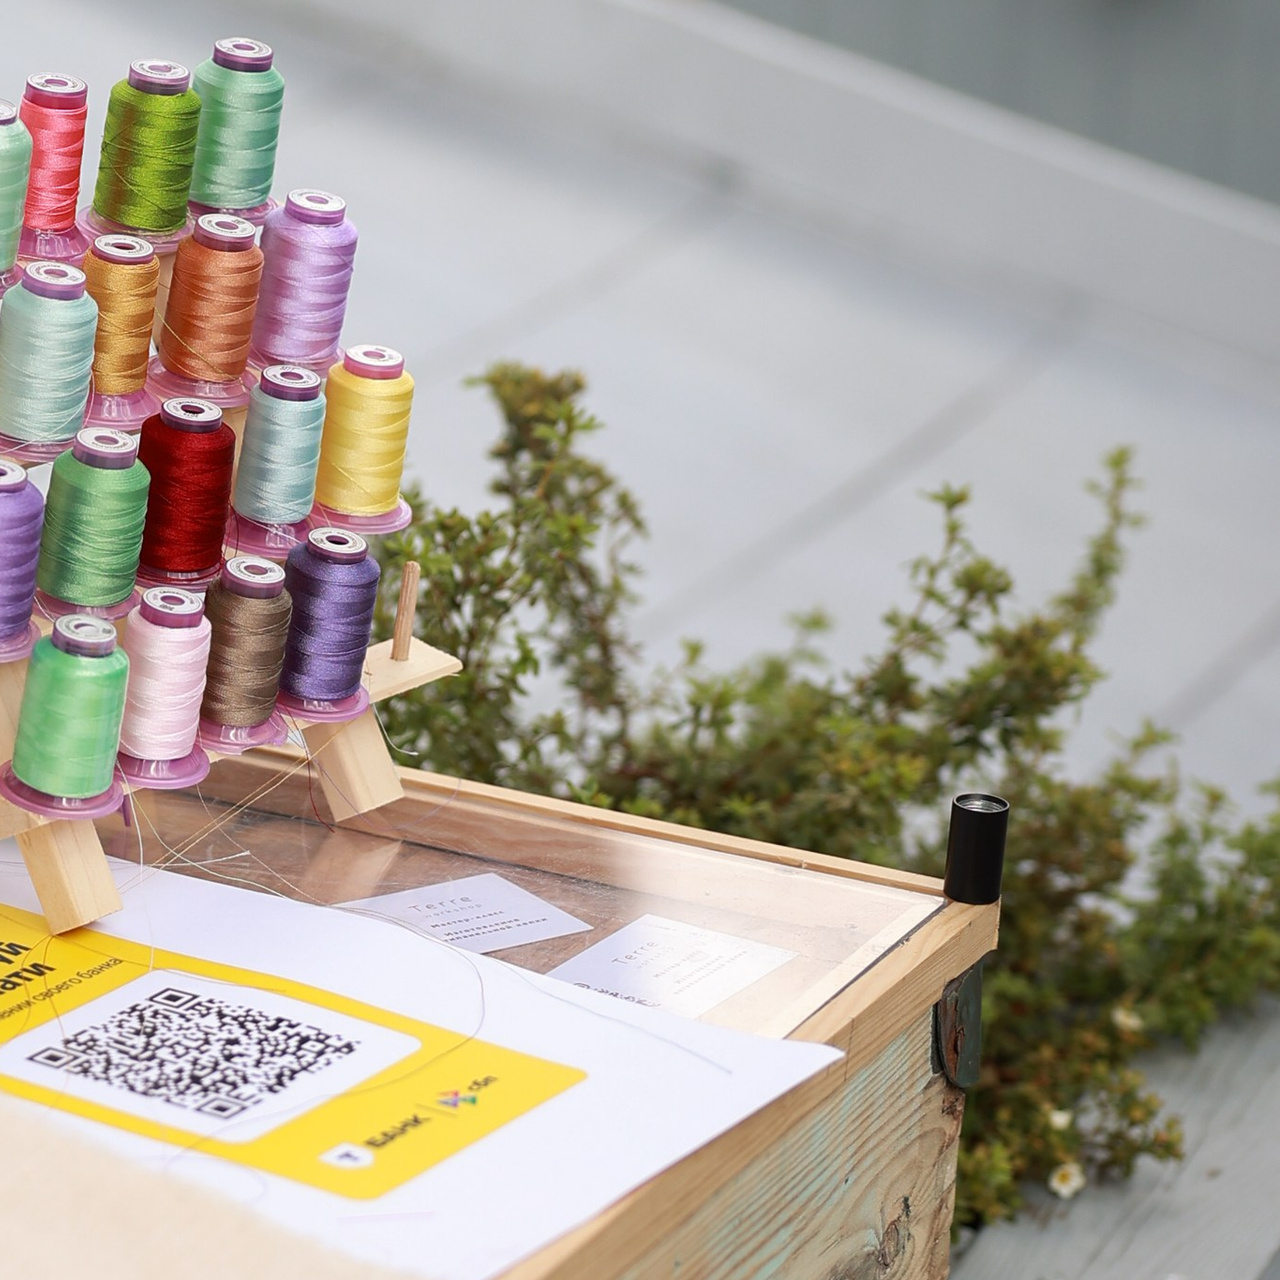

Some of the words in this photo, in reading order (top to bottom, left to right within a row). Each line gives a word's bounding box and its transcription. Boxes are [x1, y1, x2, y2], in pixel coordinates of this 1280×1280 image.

[408, 896, 472, 912] Terre
[611, 940, 660, 966] Terre
[32, 975, 82, 1003] своего
[77, 957, 124, 980] банка
